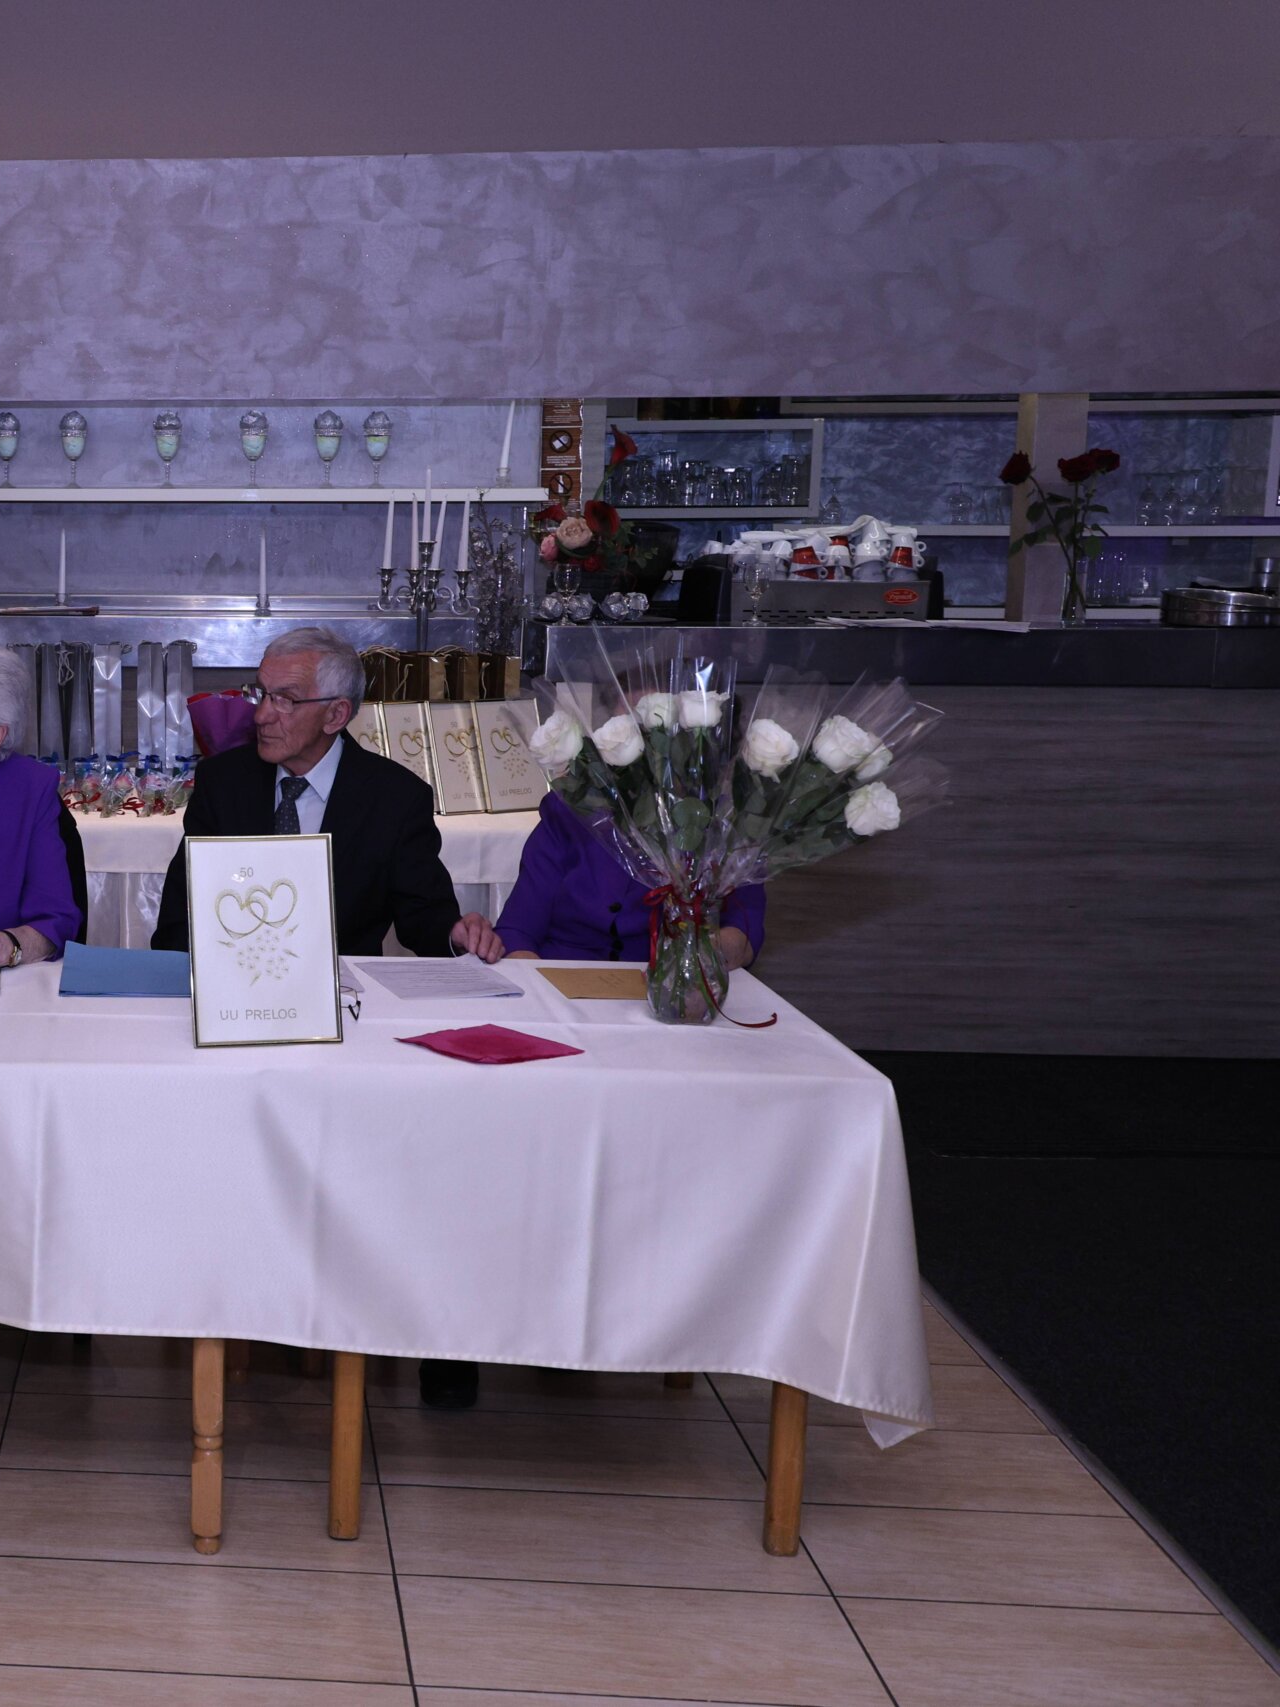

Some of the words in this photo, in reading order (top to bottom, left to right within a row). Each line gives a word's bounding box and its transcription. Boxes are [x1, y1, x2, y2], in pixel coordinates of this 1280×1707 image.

[239, 866, 254, 878] 50
[220, 1009, 239, 1021] UU
[245, 1008, 297, 1020] PRELOG
